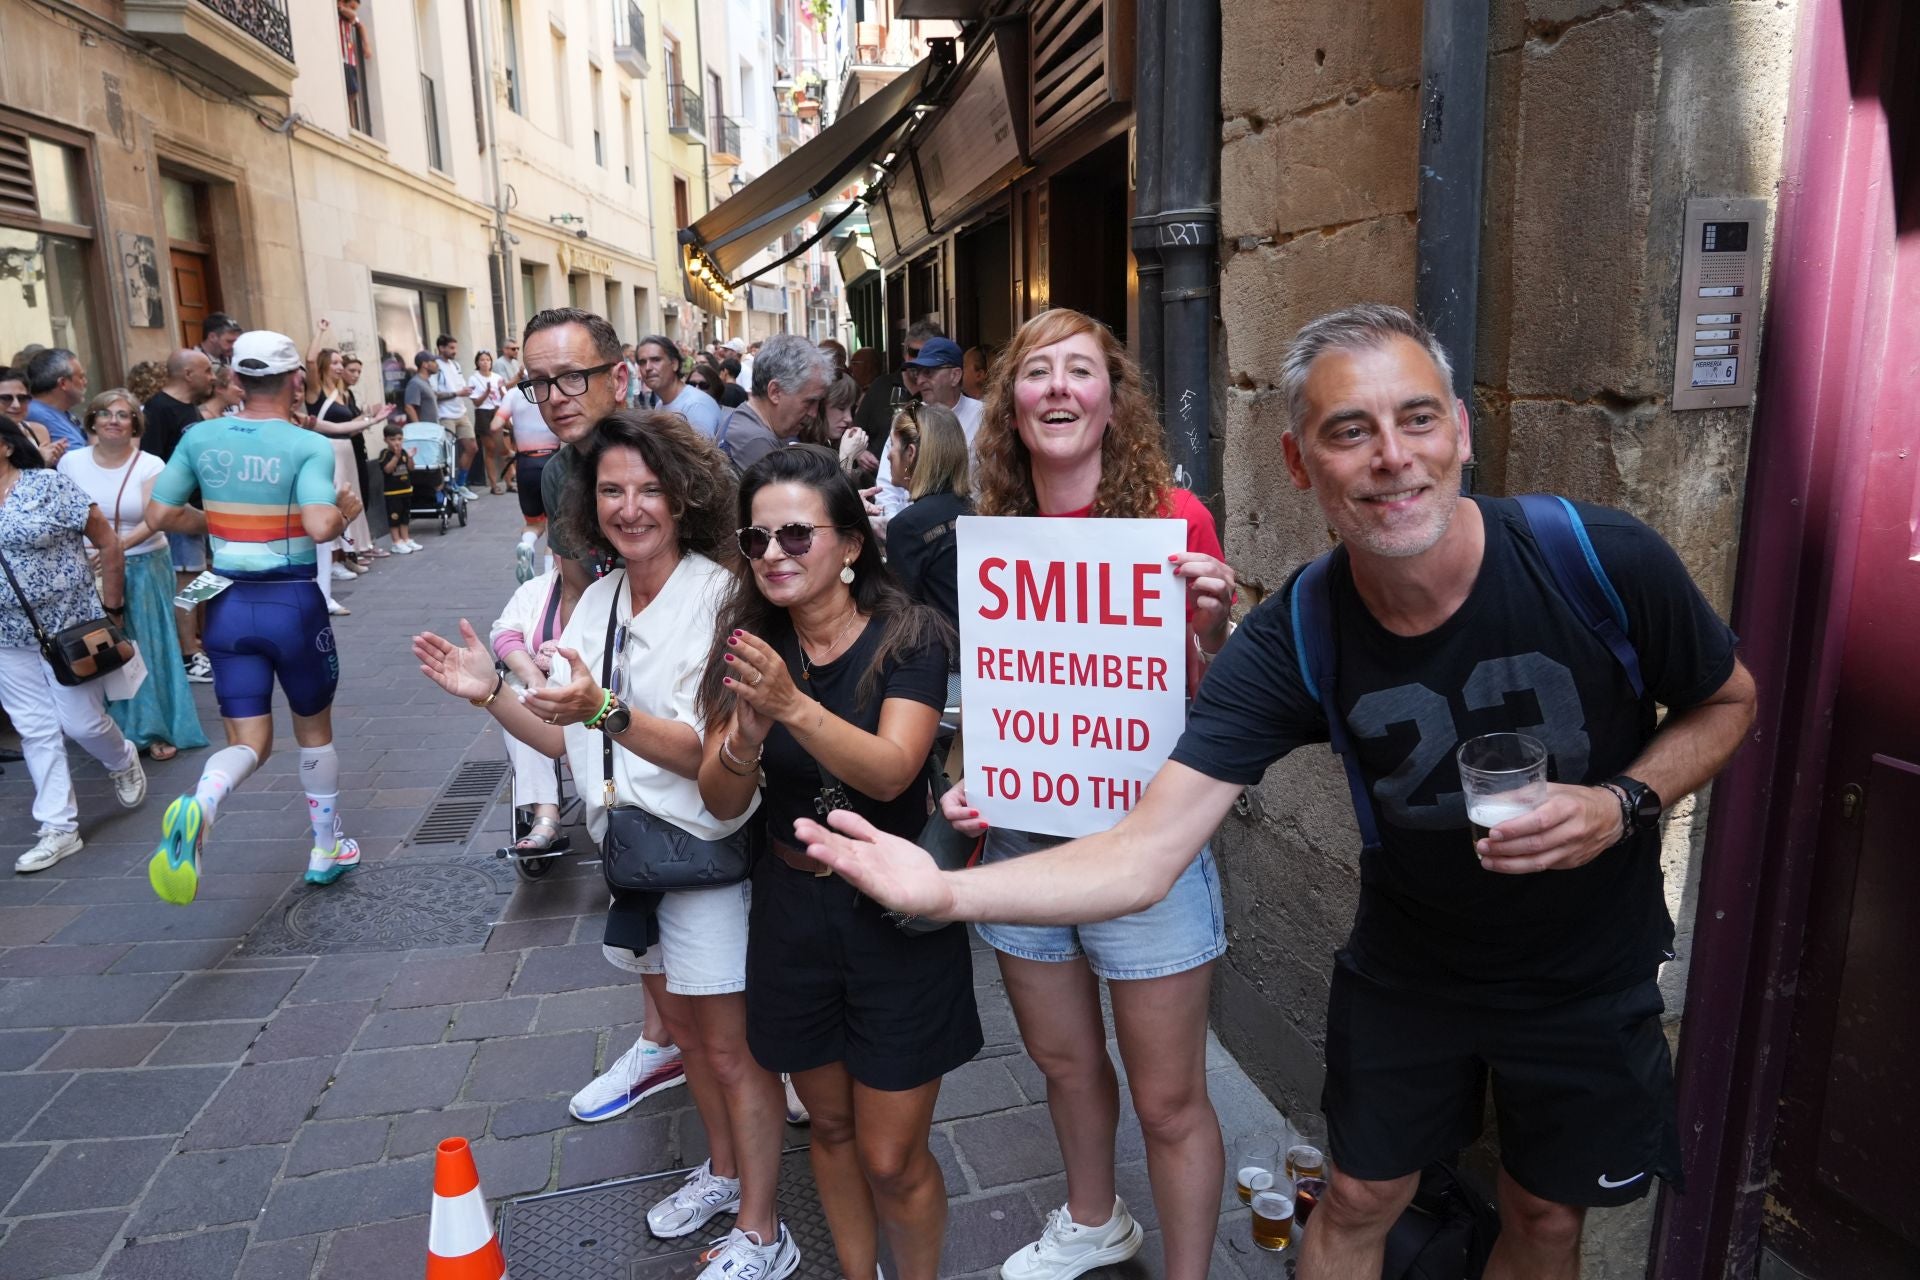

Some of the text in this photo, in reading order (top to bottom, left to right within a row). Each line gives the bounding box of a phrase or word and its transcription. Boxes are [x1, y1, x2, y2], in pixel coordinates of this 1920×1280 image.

[1159, 222, 1205, 246] LRT
[1725, 365, 1733, 378] 6
[237, 455, 280, 484] JDC
[978, 557, 1163, 627] SMILE
[977, 646, 1168, 692] REMEMBER
[992, 707, 1150, 752] YOU PAID
[1347, 651, 1592, 831] 23
[982, 765, 1151, 812] TO DO THI
